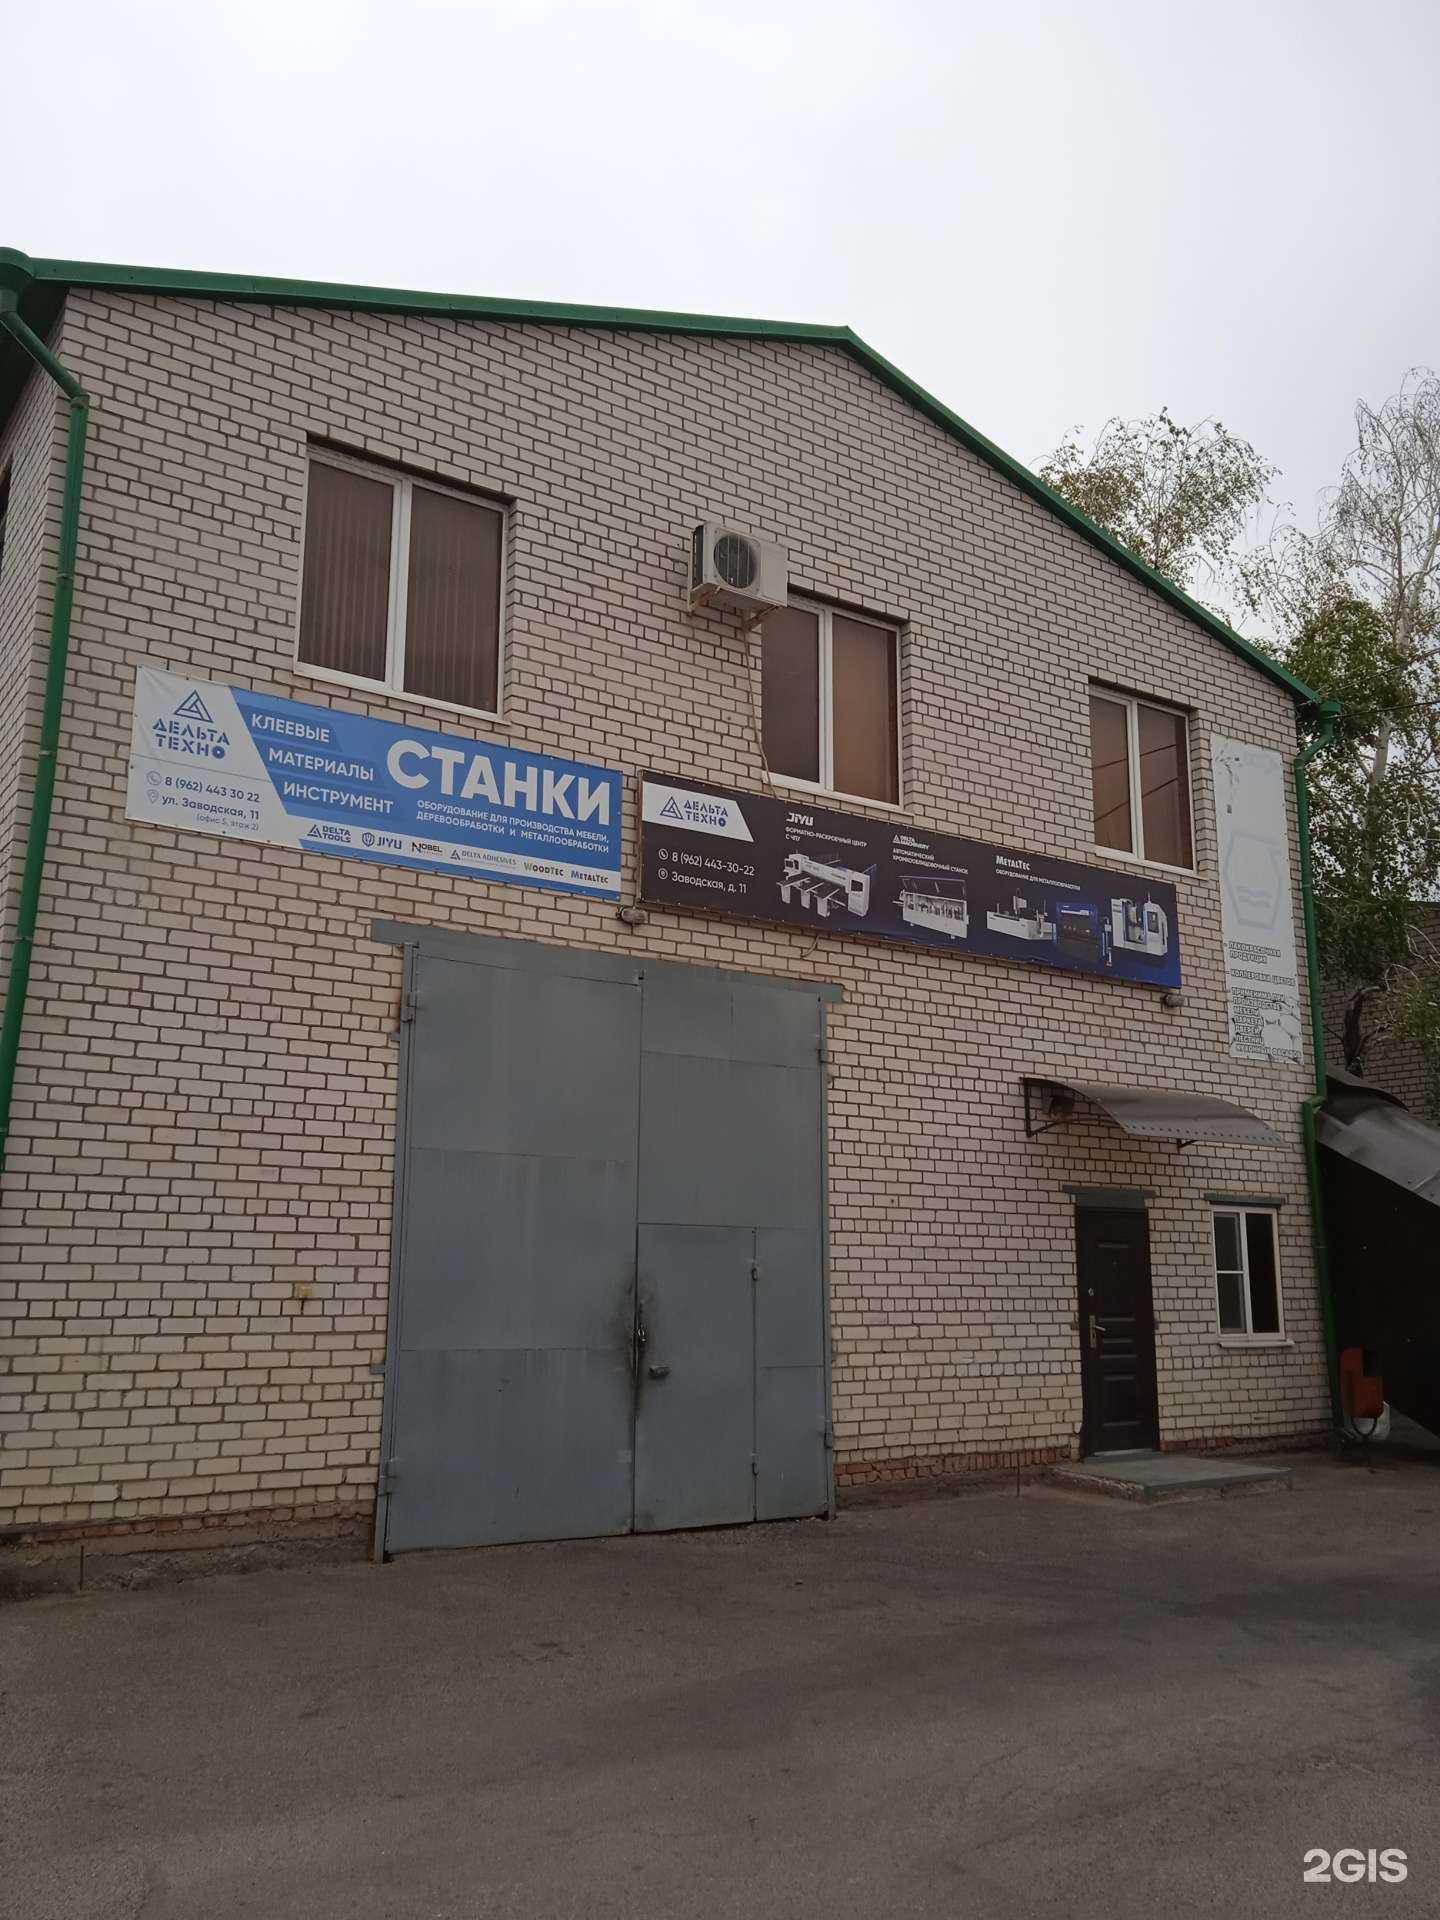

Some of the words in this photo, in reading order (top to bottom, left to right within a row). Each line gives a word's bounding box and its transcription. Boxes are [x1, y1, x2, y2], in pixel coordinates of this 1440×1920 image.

[152, 718, 230, 746] ДЕЛЬТА
[251, 713, 330, 743] КЛЕЕВЫЕ
[155, 733, 226, 759] ТЕХНО
[268, 747, 374, 781] МАТЕРИАЛЫ
[165, 776, 172, 786] 8
[175, 777, 203, 793] (962)
[206, 784, 227, 797] 443
[230, 788, 244, 800] 30
[247, 792, 260, 803] 22
[386, 739, 610, 825] СТАНКИ
[161, 795, 178, 806] ул.
[182, 797, 247, 819] Заводская,
[250, 810, 259, 820] 11
[283, 781, 394, 814] ИНСТРУМЕНТ
[684, 799, 728, 817] ДЕЛЬТА
[322, 825, 351, 836] DELTA
[416, 800, 489, 820] ОБОРУДОВАНИЕ
[490, 814, 508, 824] ДЛЯ
[509, 817, 575, 837] ПРОИЗВОДСТВА
[576, 829, 610, 843] МЕБЕЛИ,
[416, 810, 505, 834] ДЕРЕВООБРАБОТКИ
[509, 828, 516, 836] И
[520, 831, 609, 853] МЕТАЛЛООБРАБОТКИ
[685, 810, 726, 827] ТЕХНО
[323, 832, 351, 843] TOOLS
[376, 836, 402, 850] JIYU
[672, 852, 678, 861] 8
[680, 852, 703, 867] (962)
[704, 857, 755, 876] 443-30-22
[671, 871, 726, 891] Заводская,
[727, 883, 737, 893] д.
[738, 883, 747, 893] 11
